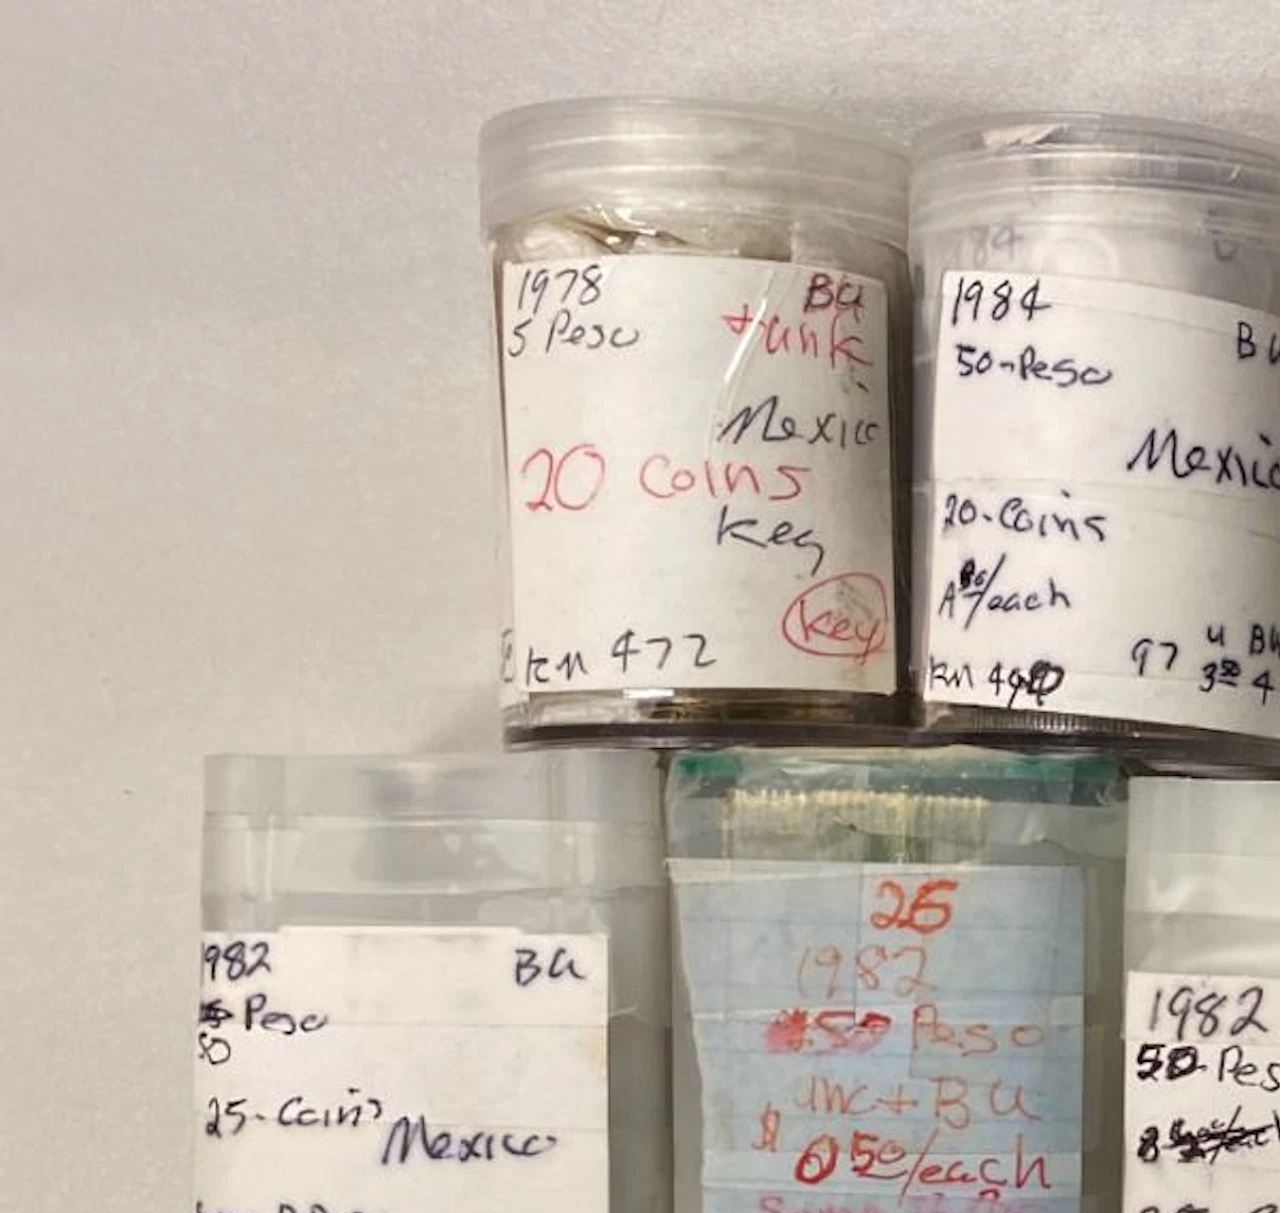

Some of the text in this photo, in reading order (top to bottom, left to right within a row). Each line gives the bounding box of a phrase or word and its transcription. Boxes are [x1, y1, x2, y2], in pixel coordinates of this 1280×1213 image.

[518, 264, 602, 310] 1978
[952, 277, 1051, 325] 1984
[508, 310, 638, 357] 5 Peso
[521, 443, 810, 512] 20 Coins
[612, 628, 716, 672] 472
[1252, 670, 1275, 704] 4
[798, 944, 938, 998] 1982
[244, 994, 328, 1034] Peso
[911, 1002, 1045, 1057] Peso
[1149, 986, 1269, 1041] 1982
[381, 1116, 557, 1166] Mexico
